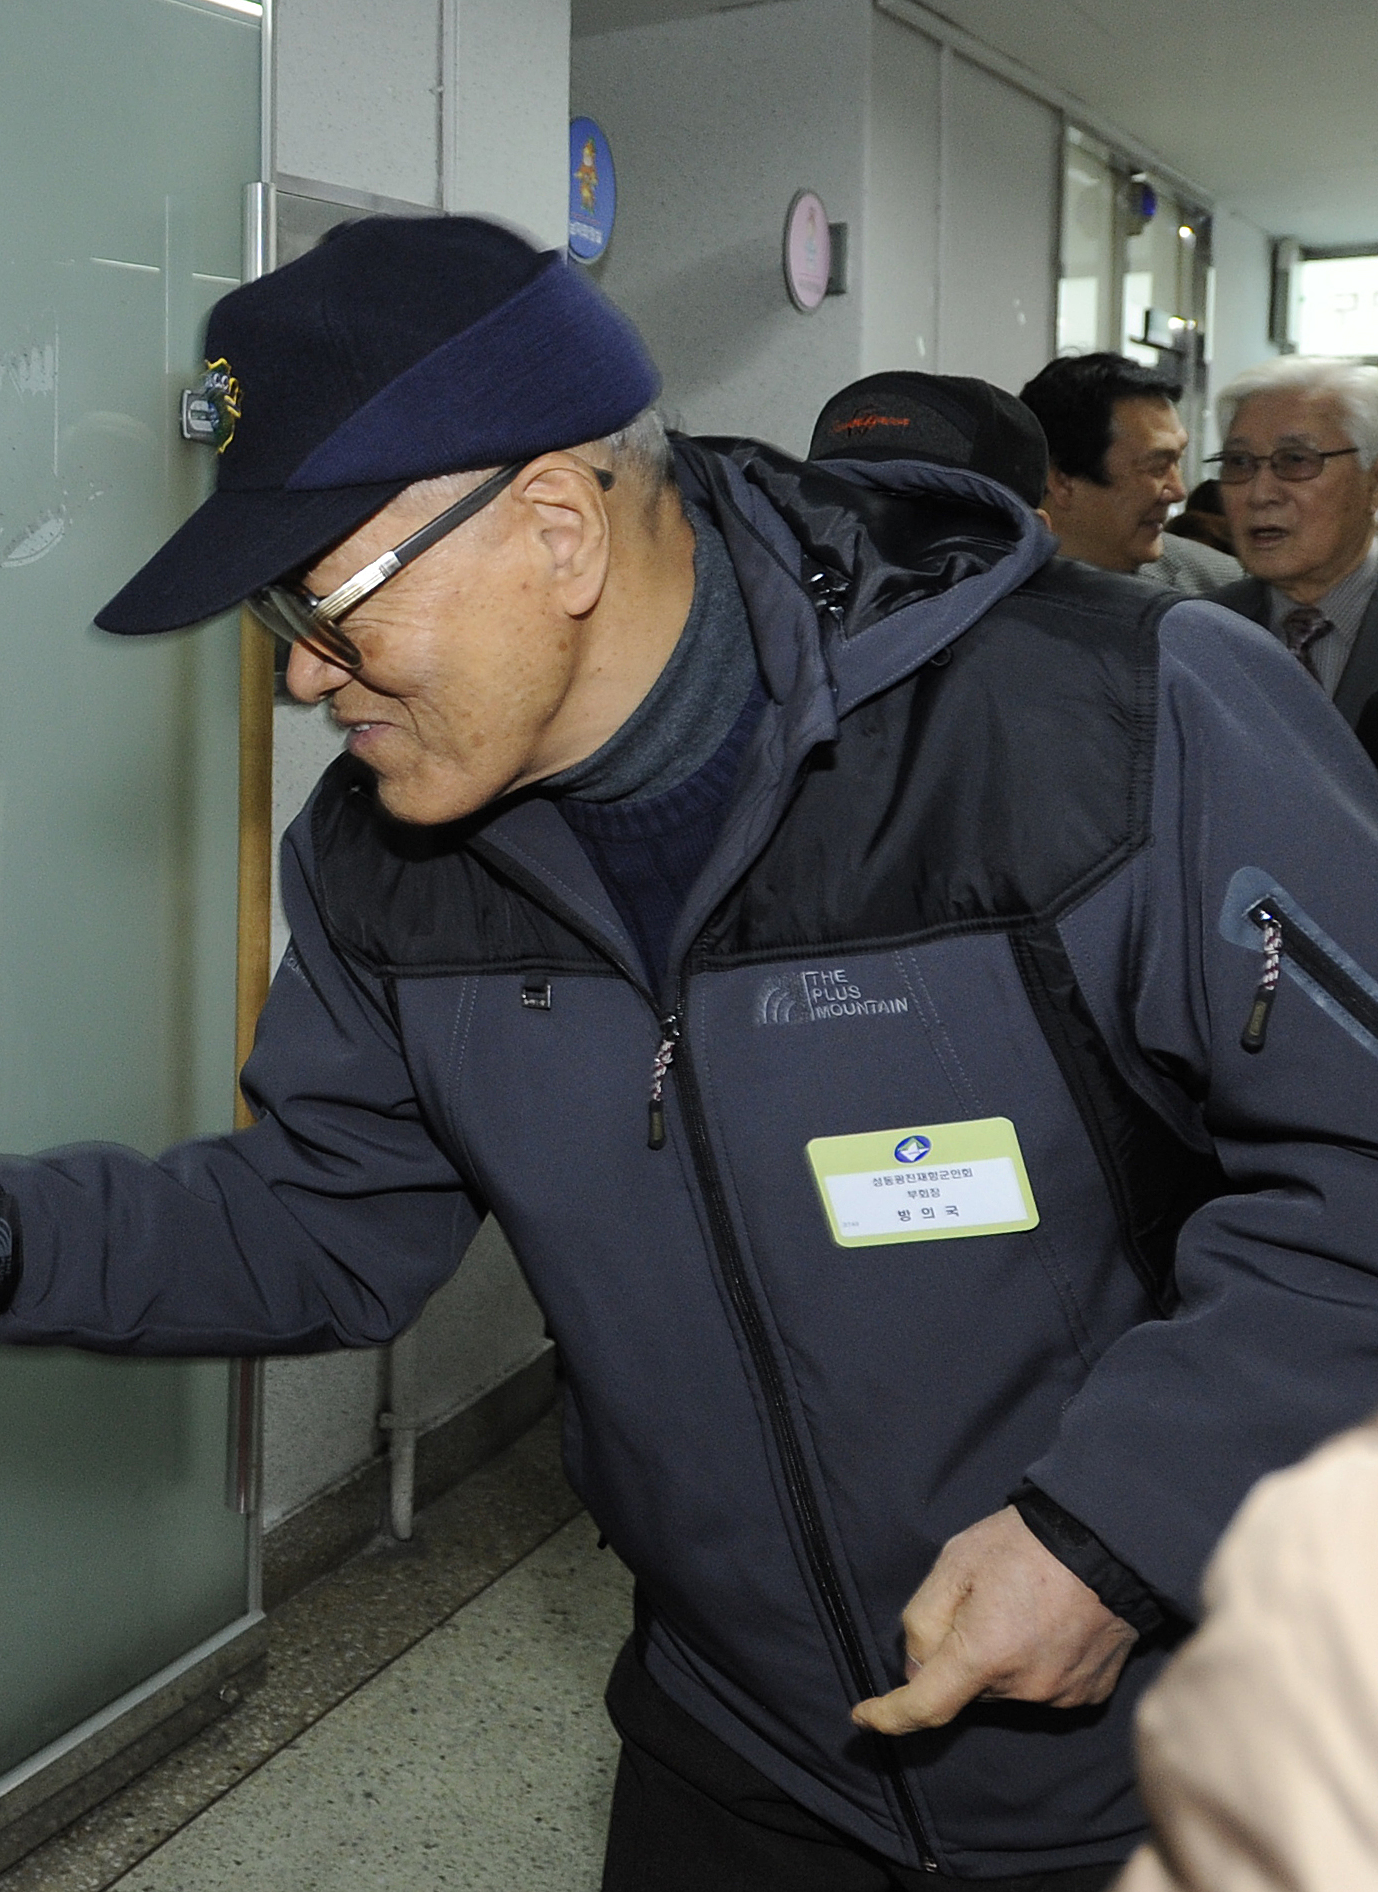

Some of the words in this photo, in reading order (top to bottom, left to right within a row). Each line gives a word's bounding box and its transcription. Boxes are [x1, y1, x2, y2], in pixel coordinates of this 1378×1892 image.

[803, 969, 849, 986] THE
[812, 985, 862, 1003] PLUS
[815, 997, 909, 1019] MOUNTAIN
[872, 1167, 974, 1188] 성동광진재향군인회
[907, 1188, 941, 1200] 부회장
